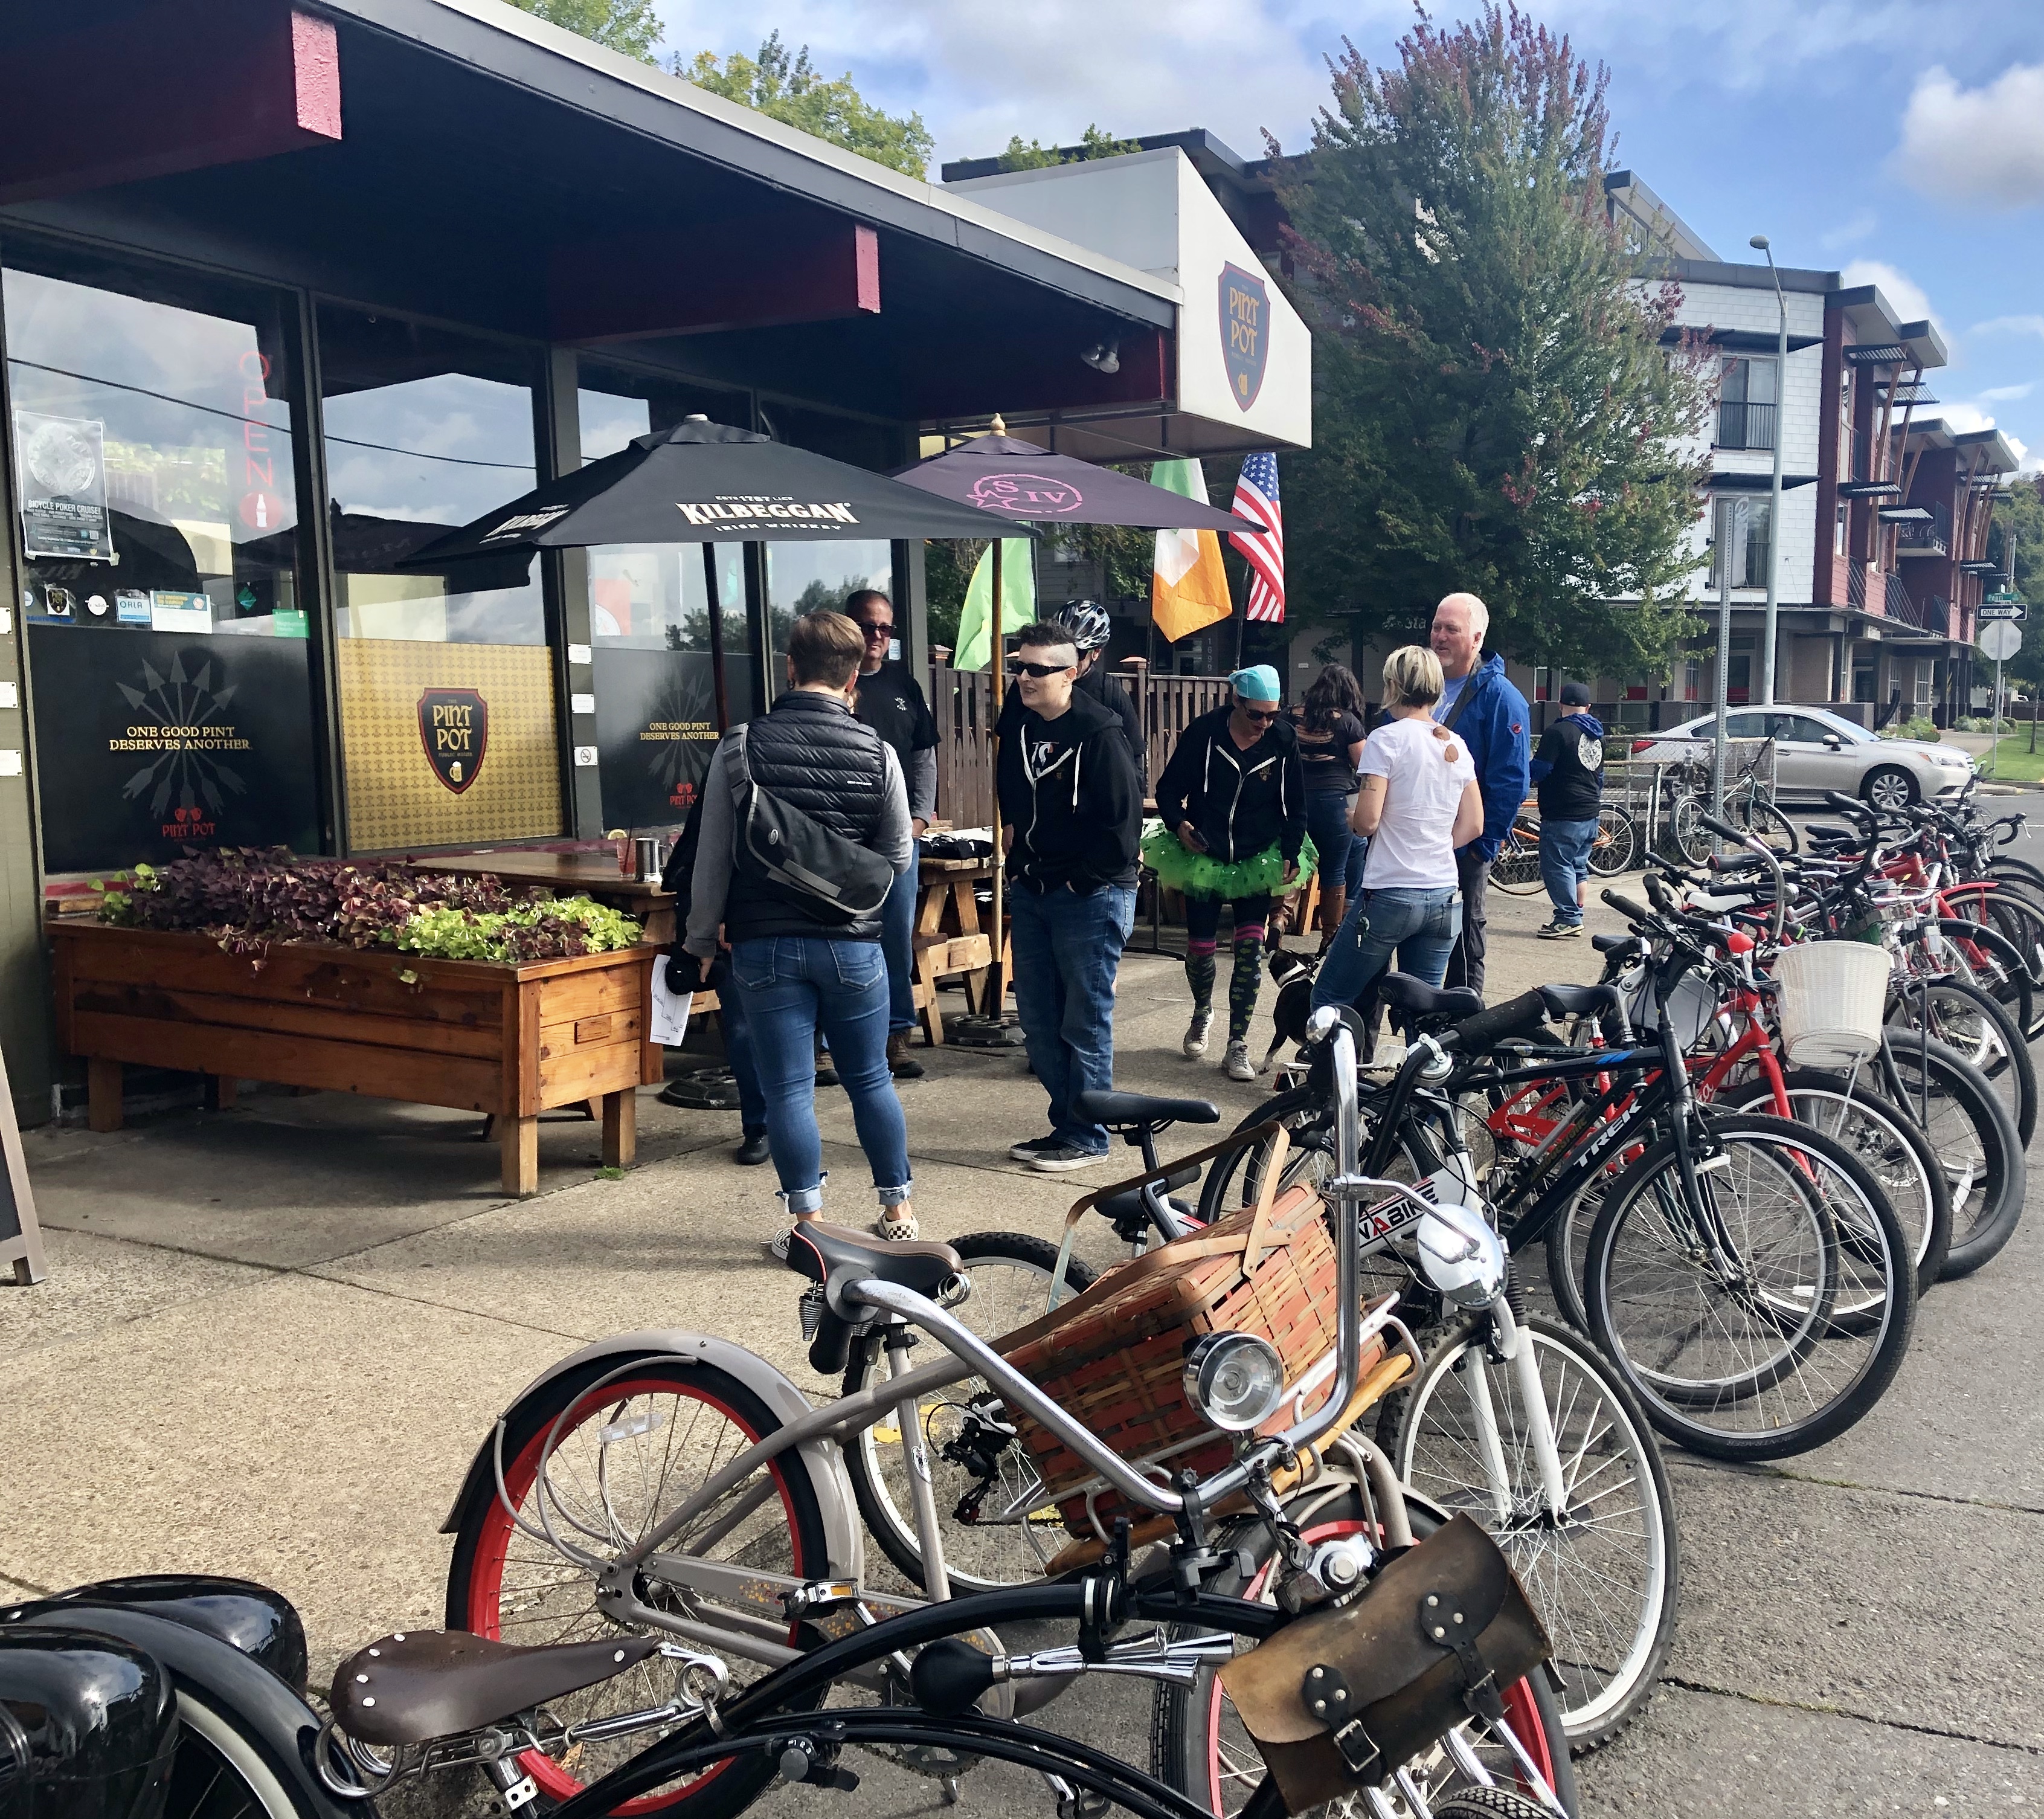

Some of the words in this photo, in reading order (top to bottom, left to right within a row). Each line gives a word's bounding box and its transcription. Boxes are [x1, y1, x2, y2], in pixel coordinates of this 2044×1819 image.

[1229, 286, 1259, 327] PINT
[1230, 319, 1258, 356] POT
[239, 350, 274, 488] OPEN
[992, 480, 1019, 492] S
[28, 500, 54, 510] BICYCLE
[56, 502, 76, 513] POKER
[77, 504, 101, 515] CRUISE!
[675, 502, 861, 525] KILBEGGAN
[715, 523, 760, 532] IRISH
[432, 705, 472, 727] PINT
[127, 726, 158, 737] ONE
[161, 726, 199, 737] GOOD
[202, 726, 235, 736] PINT
[436, 728, 472, 750] POT
[640, 732, 680, 741] DESERVES
[109, 739, 181, 751] DESERVES
[670, 795, 684, 805] PINT
[162, 824, 188, 837] PINT
[193, 822, 216, 835] POT
[1573, 1098, 1643, 1168] TREK
[765, 1590, 776, 1598] Fat
